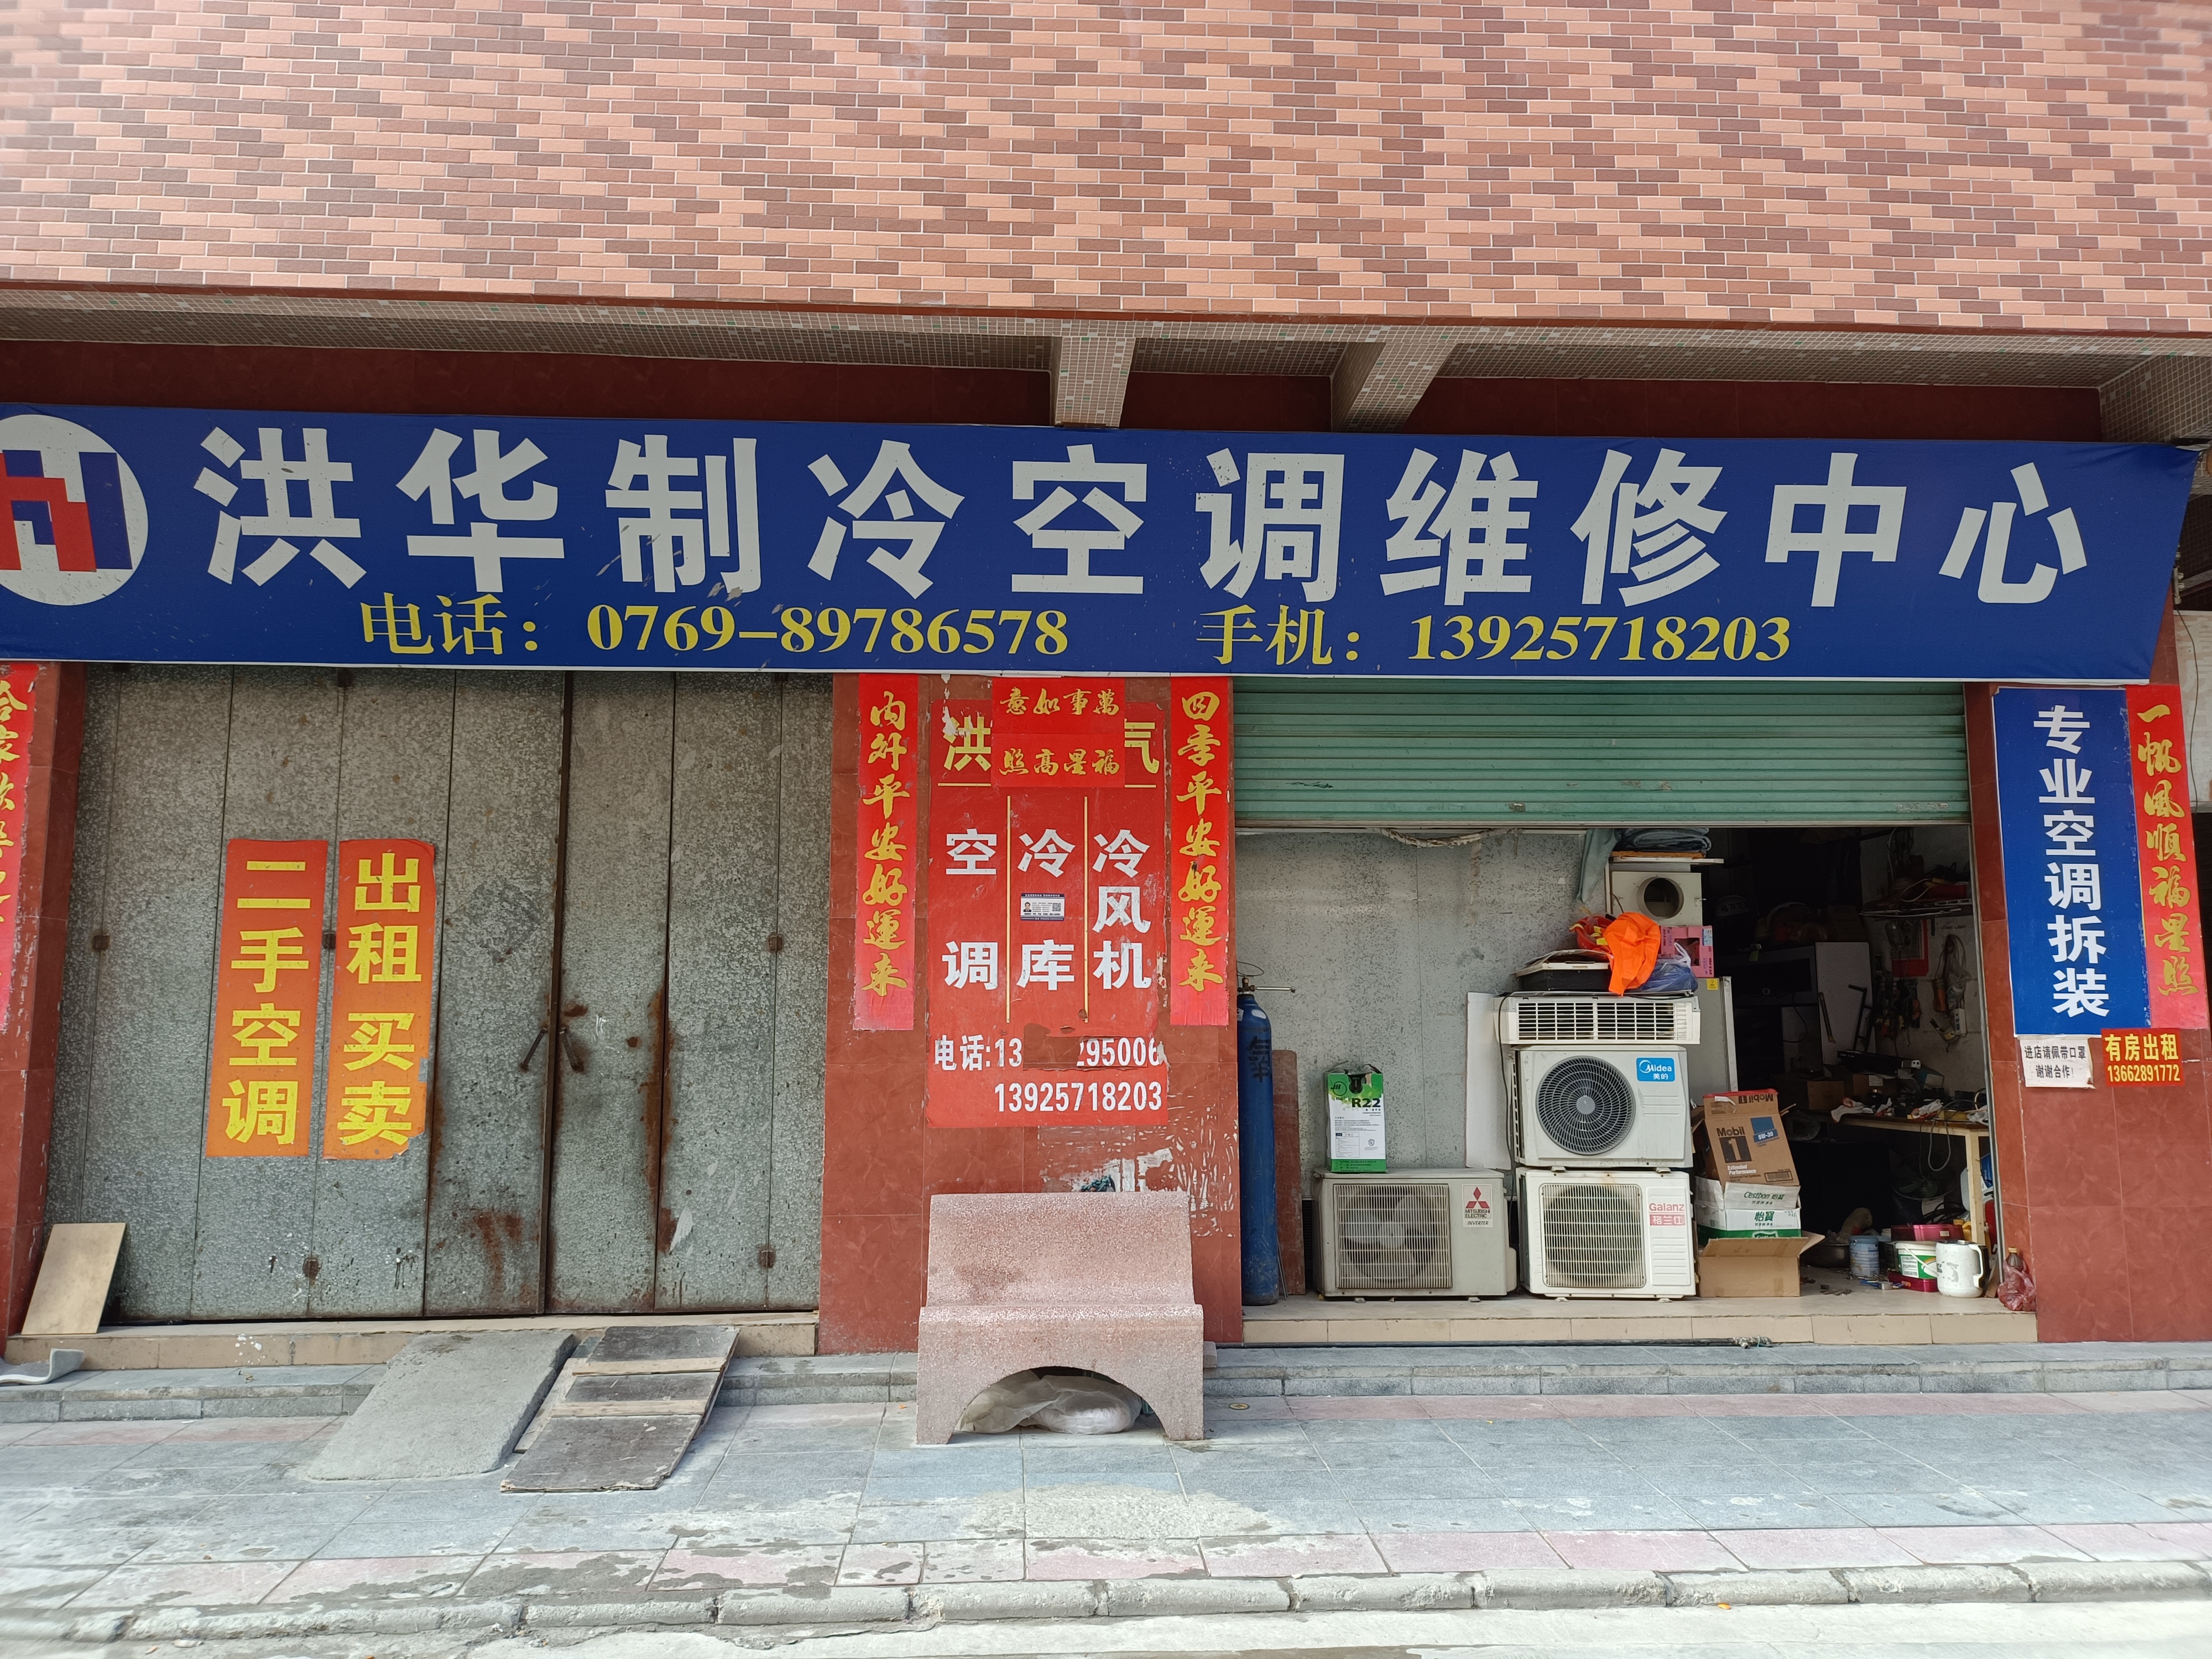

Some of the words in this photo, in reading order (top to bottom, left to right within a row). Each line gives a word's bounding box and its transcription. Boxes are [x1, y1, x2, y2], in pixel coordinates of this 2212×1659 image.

[194, 427, 2088, 607] 洪华制冷空调维修中心
[1408, 615, 1790, 661] 13925718203
[2033, 705, 2110, 1018] 专业空调拆装
[222, 860, 311, 1145] 二手空调
[337, 853, 422, 1146] 出租买卖
[2024, 1046, 2086, 1060] 进店请佩带口罩
[2104, 1034, 2179, 1061] 有房出租
[2107, 1064, 2180, 1083] 13662891772
[994, 1081, 1162, 1112] 13925718203
[1351, 1098, 1381, 1108] R22
[1749, 1094, 1773, 1103] Mobil
[1716, 1126, 1745, 1137] Mobil
[1757, 1131, 1774, 1140] 5W-30
[1648, 1203, 1685, 1212] Galanz
